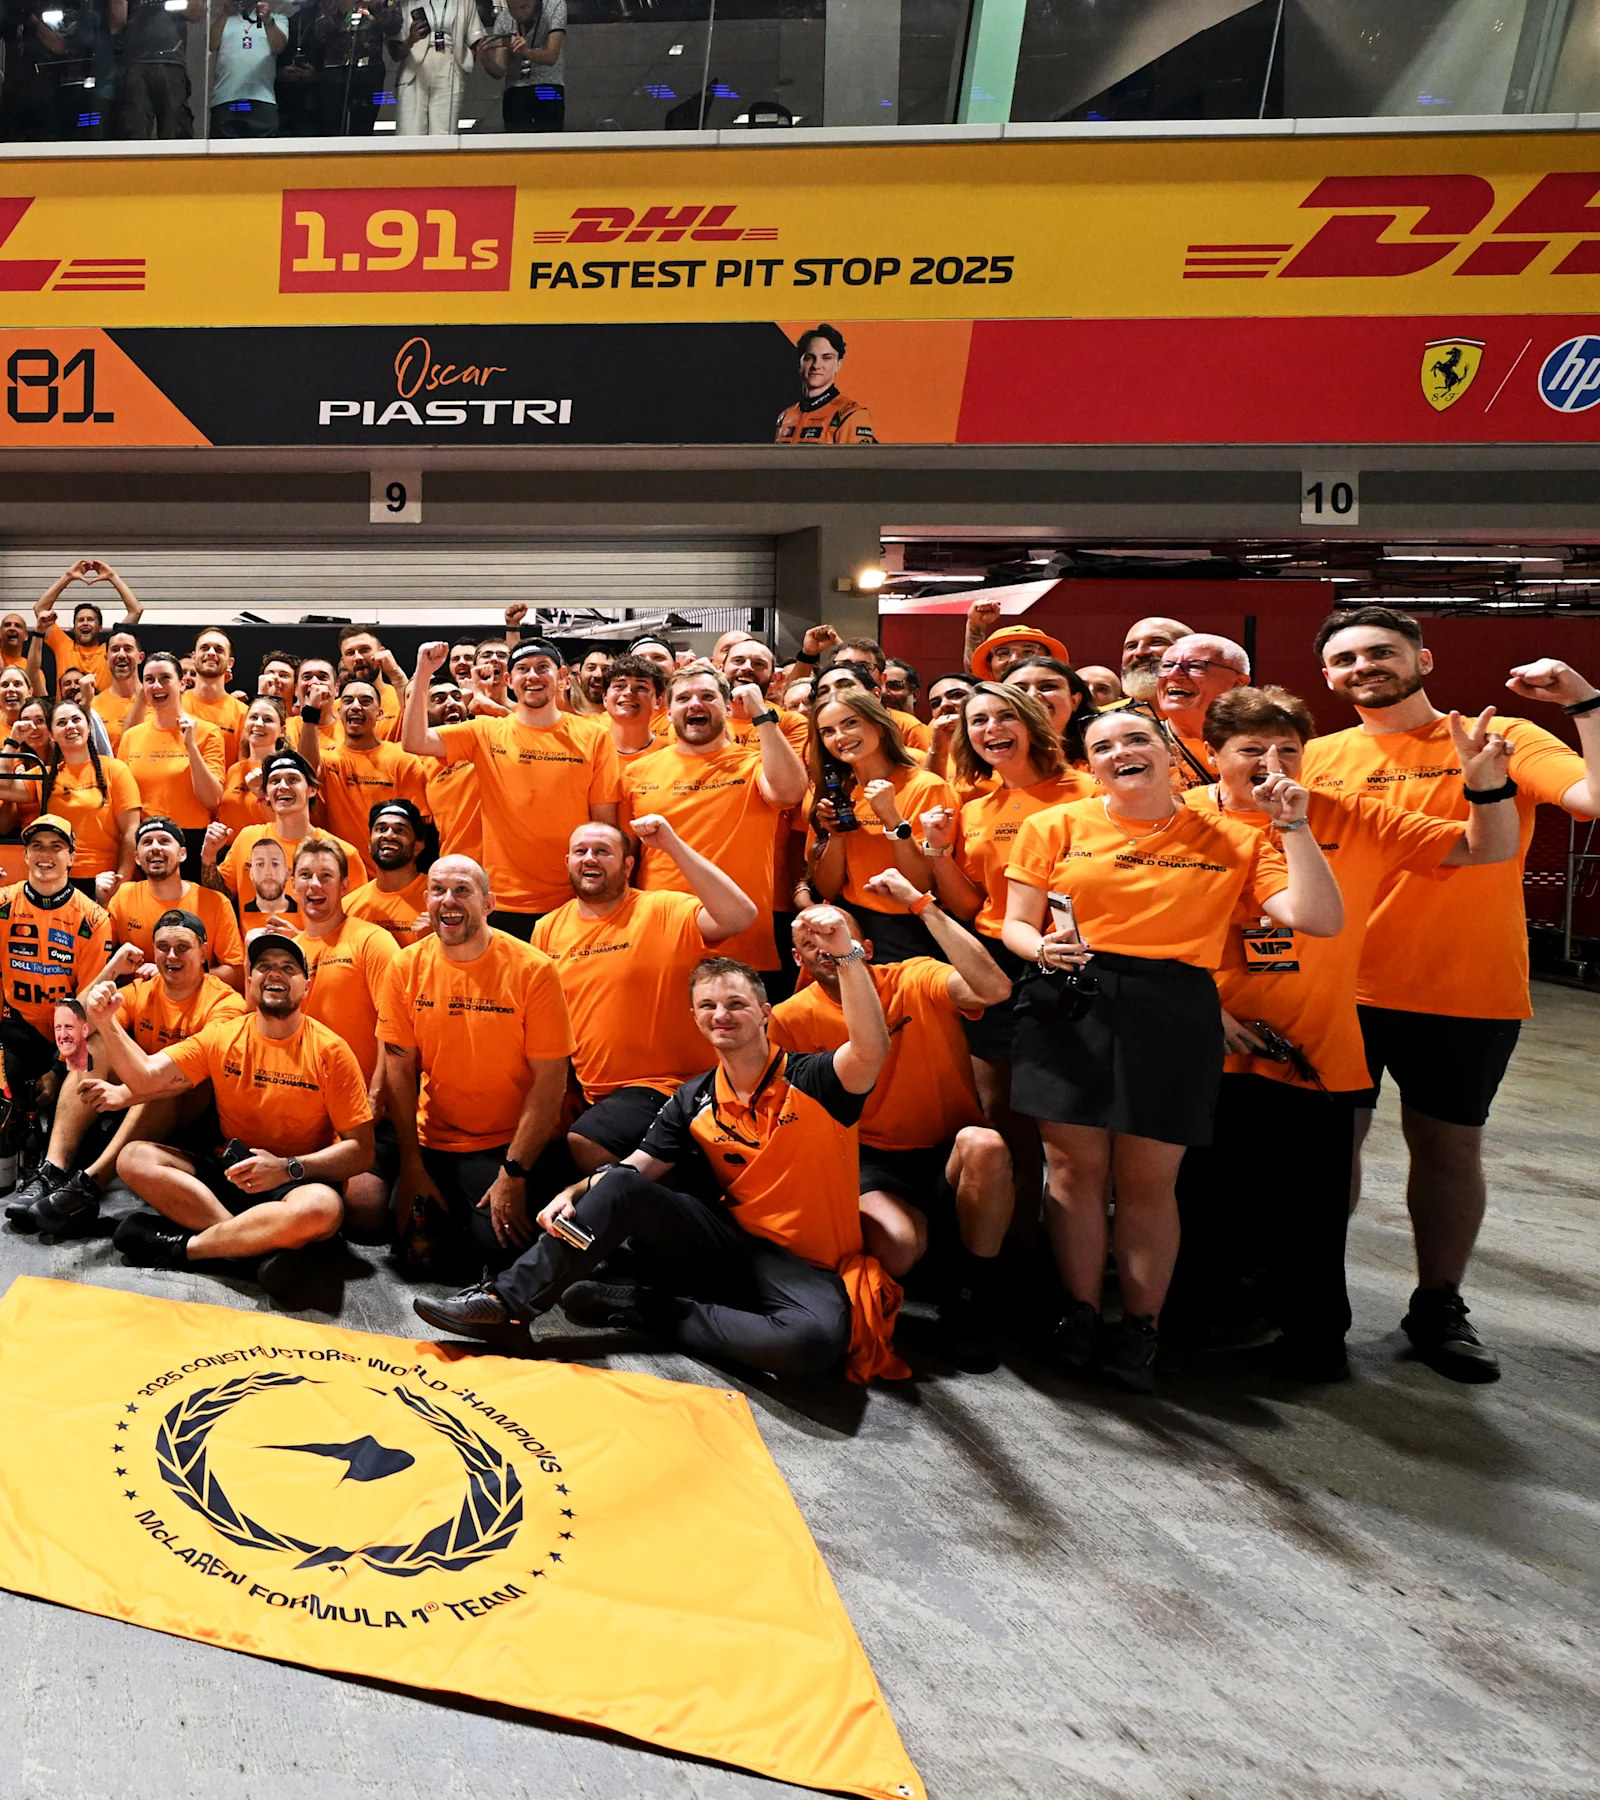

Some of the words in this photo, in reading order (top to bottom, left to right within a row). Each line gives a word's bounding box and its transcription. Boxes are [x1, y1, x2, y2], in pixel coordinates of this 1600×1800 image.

[565, 205, 745, 243] DHL
[1278, 172, 1600, 278] DH
[530, 261, 706, 289] FASTEST
[714, 259, 776, 288] PIT
[791, 257, 900, 286] STOP
[910, 256, 1014, 285] 2025
[395, 336, 507, 399] Oscar
[1547, 338, 1600, 410] hp
[7, 348, 115, 424] 81
[319, 400, 573, 426] PIASTRI
[386, 482, 407, 513] 9
[1307, 482, 1353, 514] 10
[519, 753, 542, 761] WORLD
[543, 756, 584, 764] CHAMPIONS
[1367, 774, 1407, 784] WORLD
[1116, 855, 1155, 866] WORLD
[1156, 860, 1227, 873] CHAMPIONS
[127, 922, 142, 930] TEAM
[590, 942, 630, 955] CHAMPIONS
[1250, 941, 1292, 956] VIP
[12, 959, 31, 971] DELL
[472, 1005, 515, 1014] CHAMPIONS
[137, 1370, 183, 1396] 2025
[367, 1357, 449, 1392] WORLD
[248, 1583, 408, 1628] FORMULA
[442, 1583, 528, 1622] TEAM
